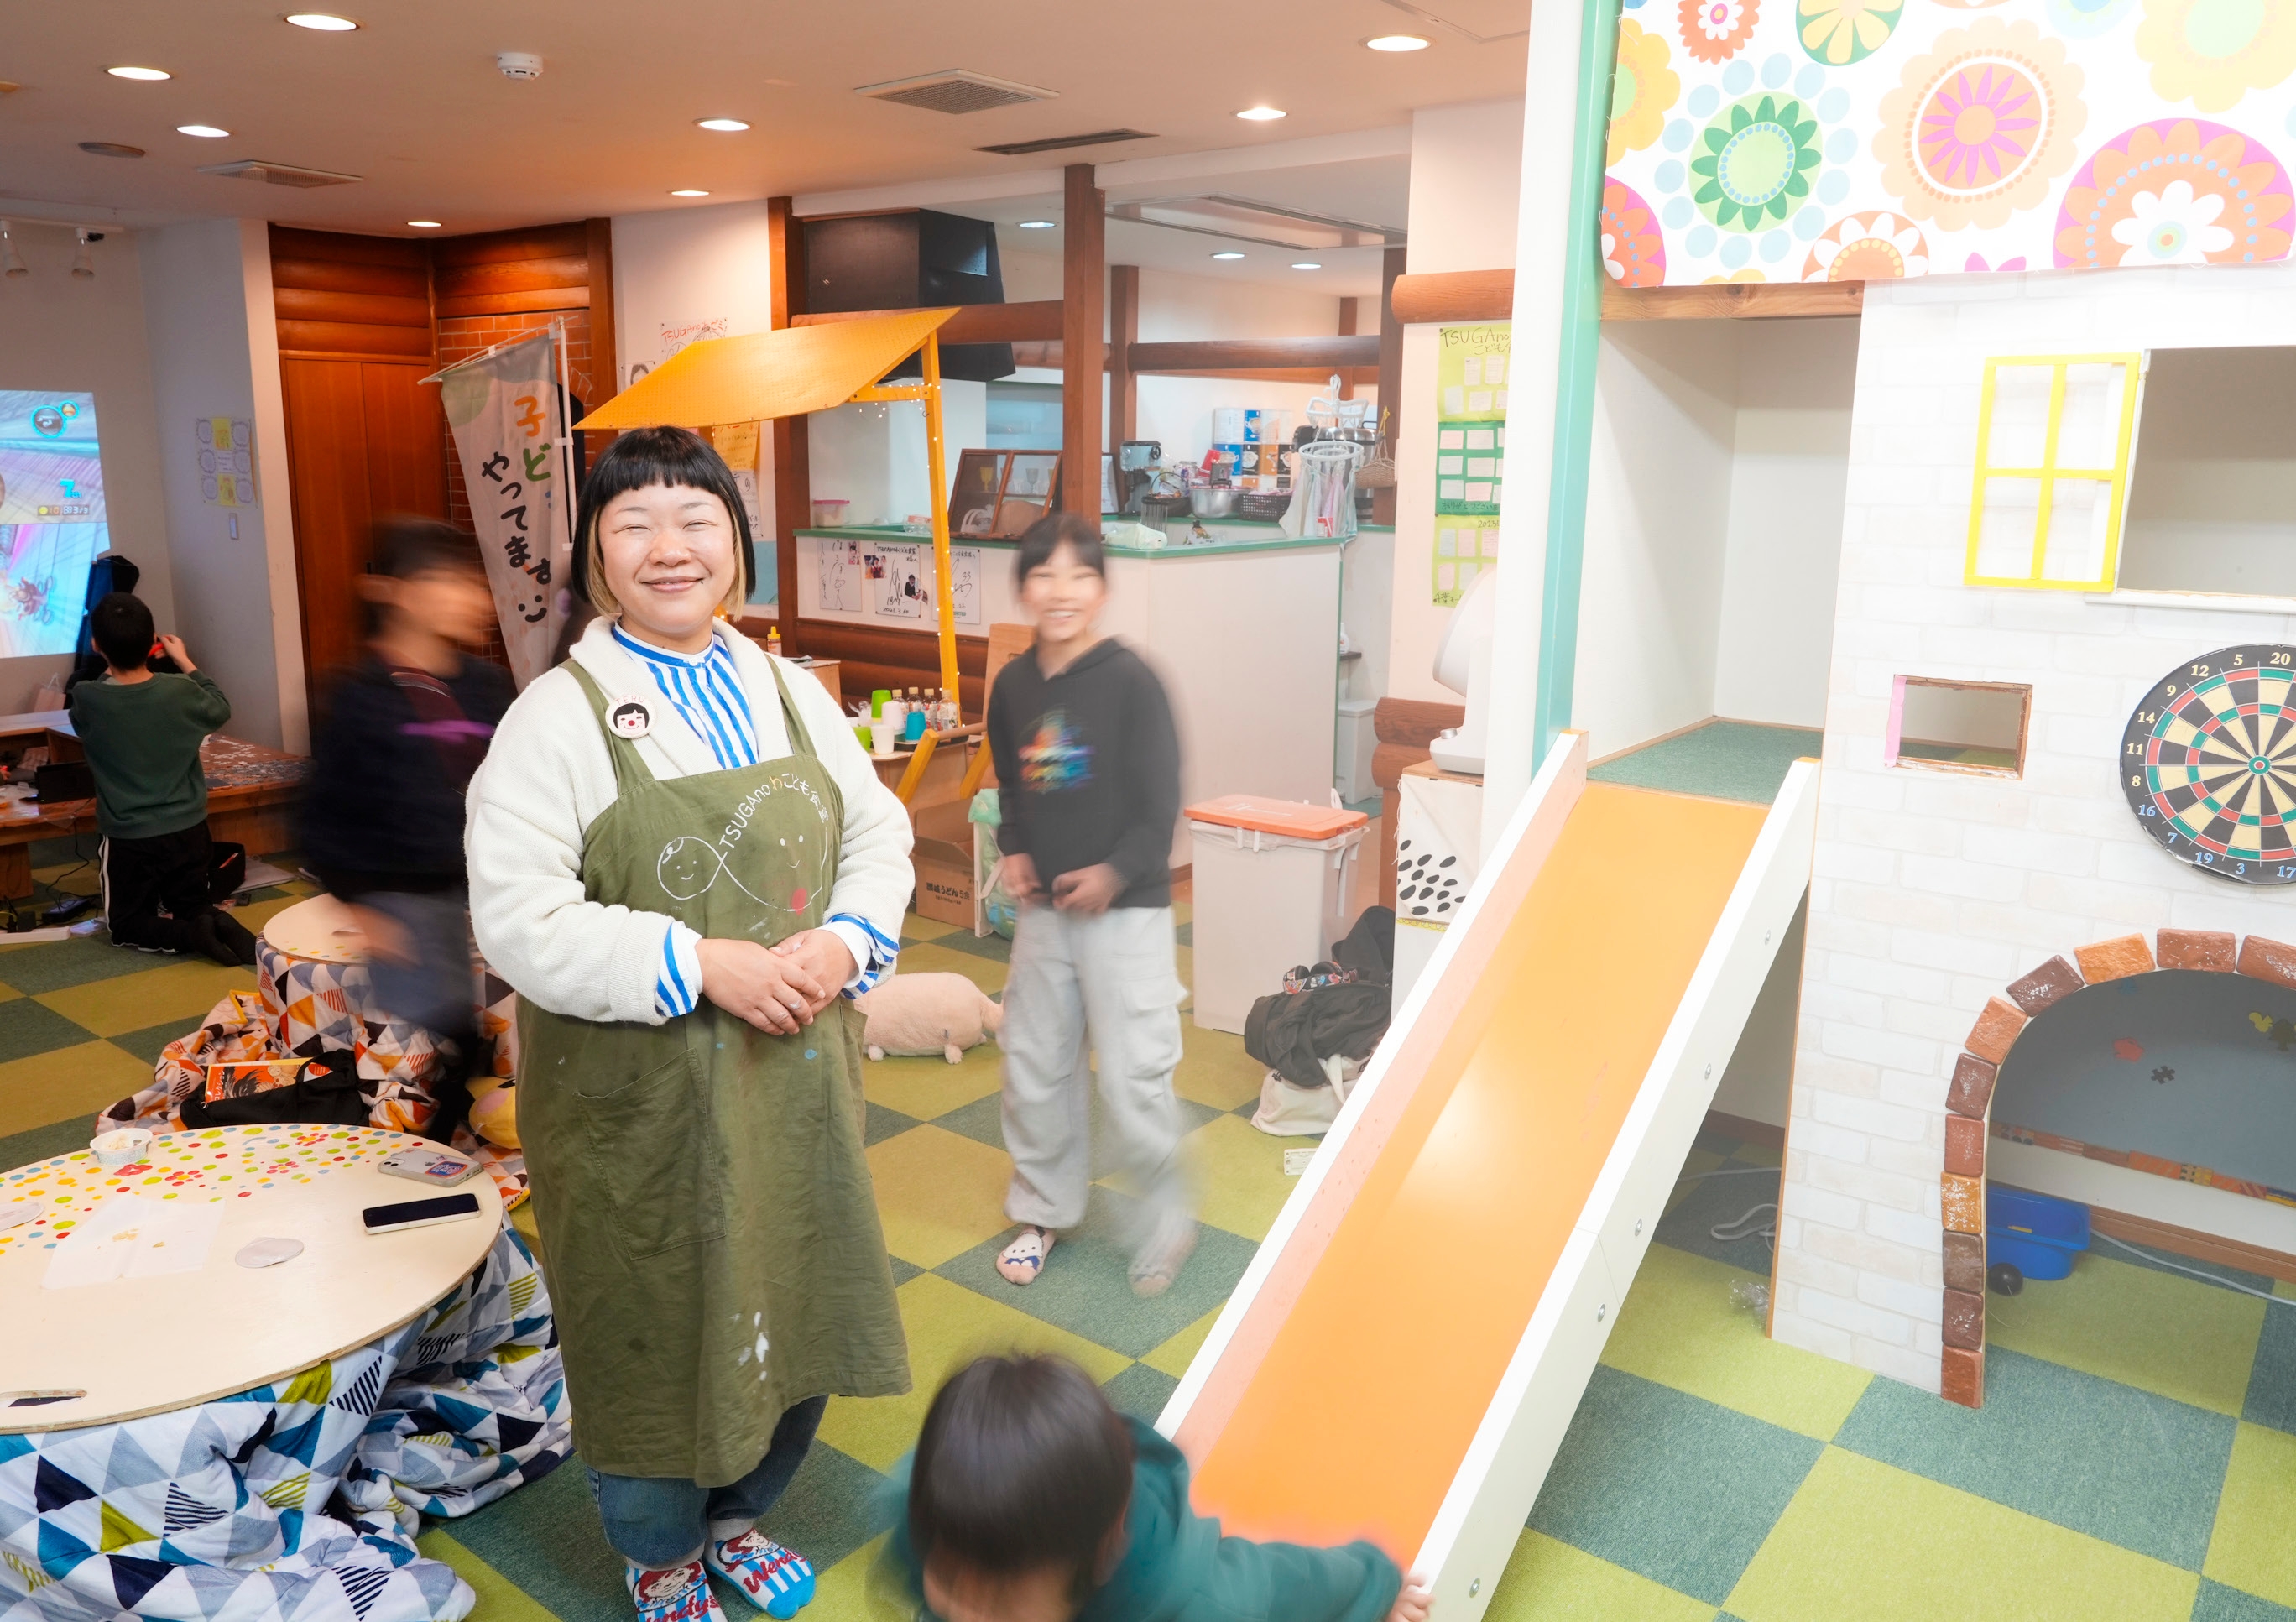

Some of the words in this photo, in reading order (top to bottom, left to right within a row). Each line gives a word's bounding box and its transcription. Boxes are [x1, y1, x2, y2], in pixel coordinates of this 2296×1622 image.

[481, 451, 551, 585] やってます
[2234, 654, 2244, 665] 5
[2270, 652, 2291, 665] 20
[2190, 665, 2209, 677] 12
[2167, 685, 2177, 696] 9
[614, 695, 645, 706] TERU
[2137, 712, 2156, 724] 14
[2126, 743, 2143, 755] 11
[2132, 776, 2141, 787] 8
[2138, 804, 2156, 817] 16
[2167, 832, 2177, 844] 7
[2194, 853, 2214, 864] 19
[2236, 863, 2246, 874] 3
[2277, 866, 2296, 879] 17
[646, 1595, 720, 1622] ndy's
